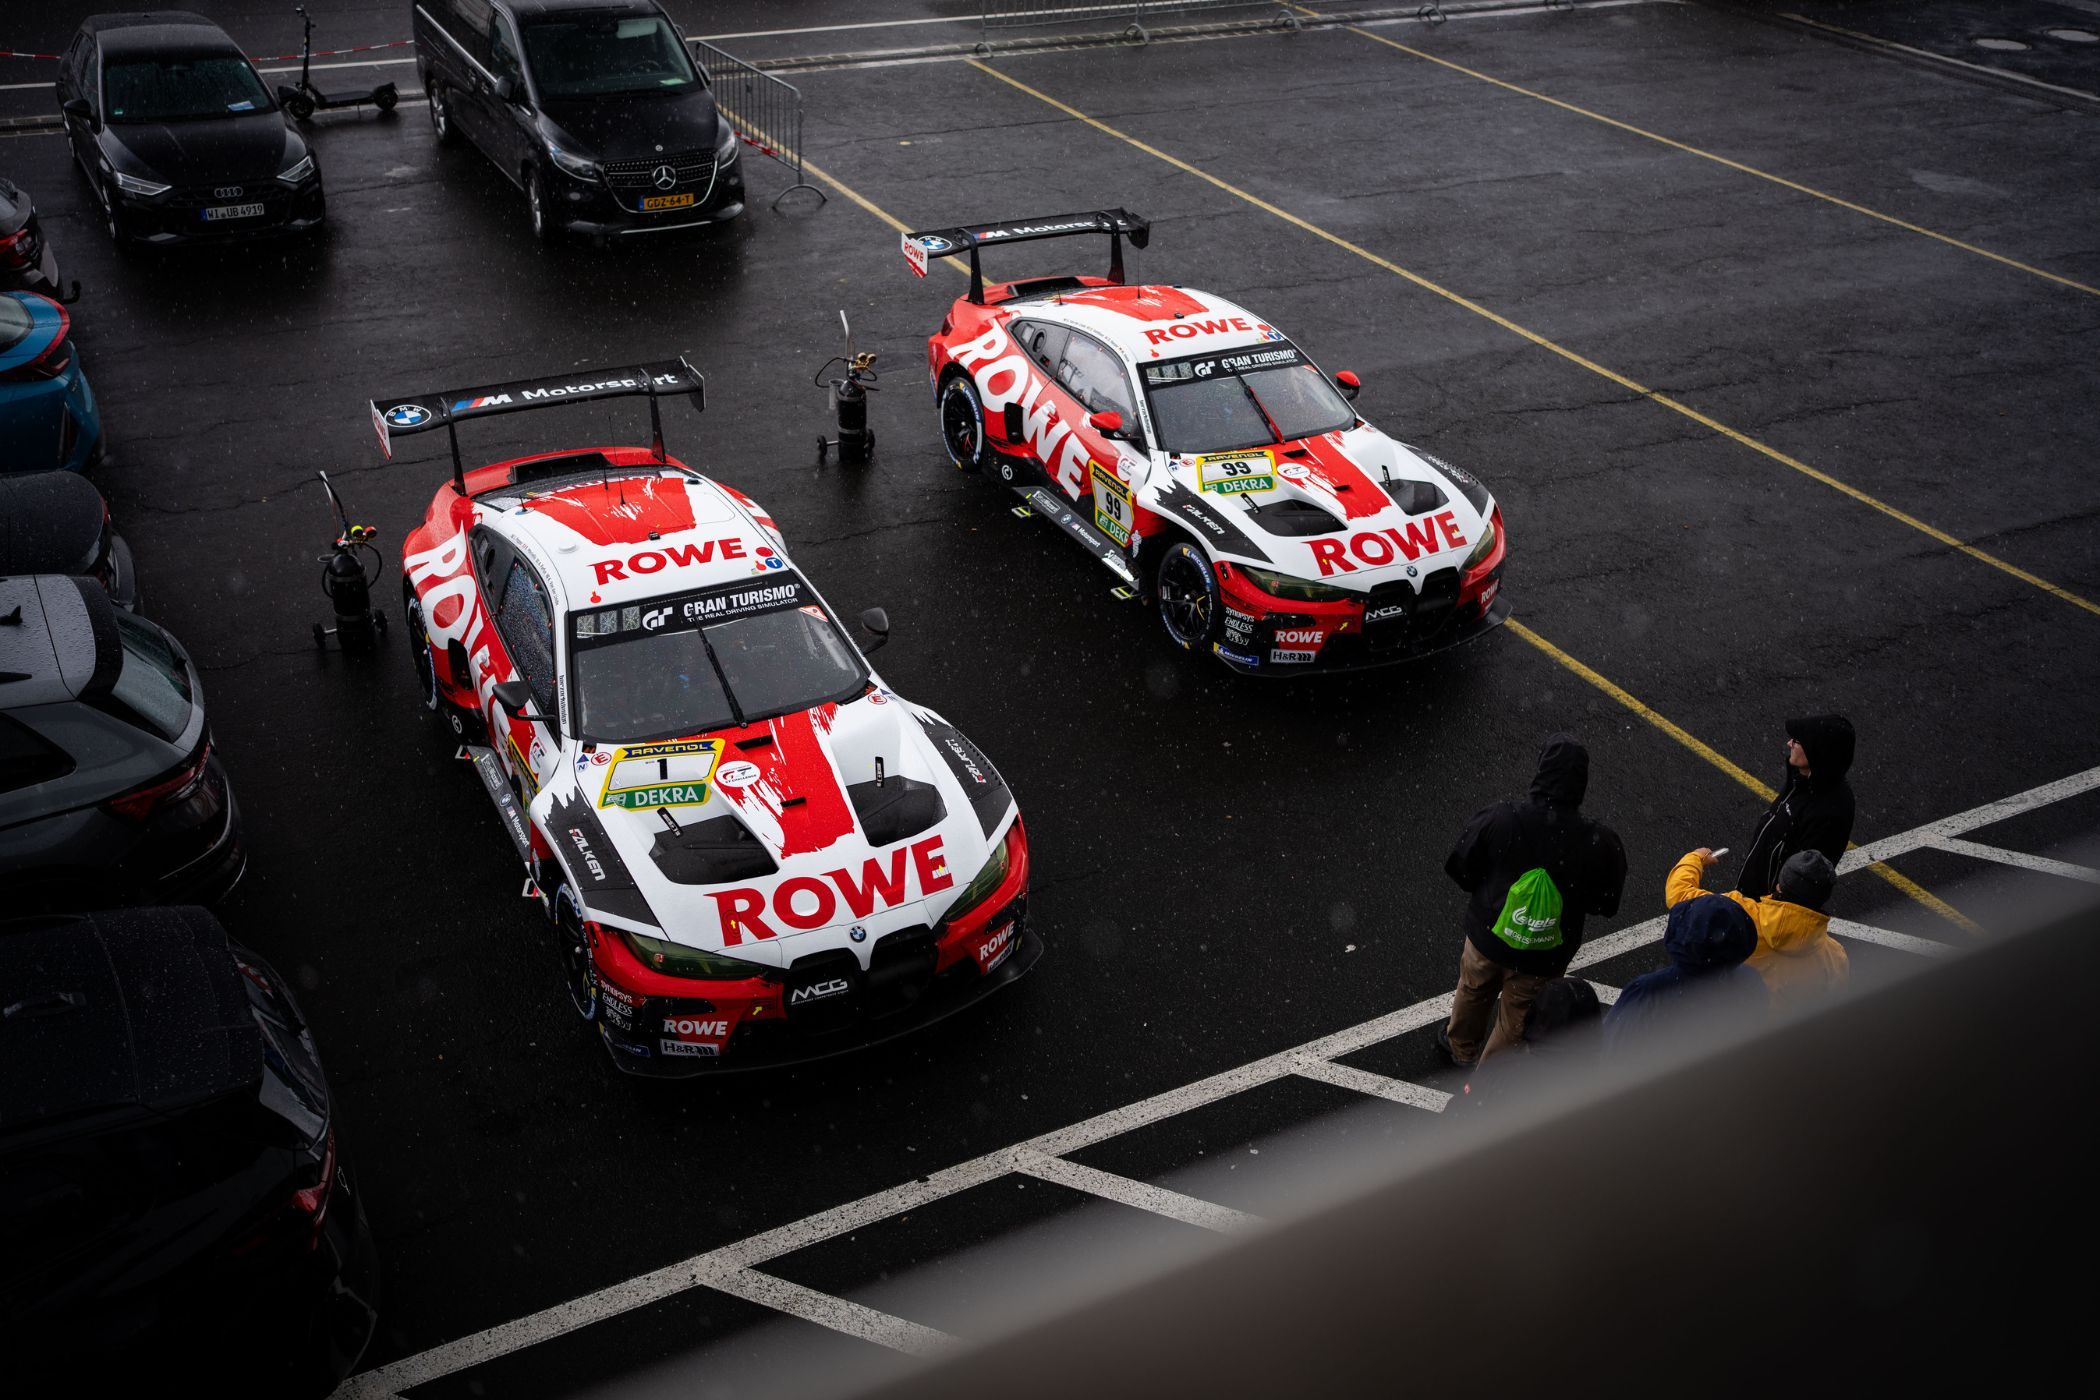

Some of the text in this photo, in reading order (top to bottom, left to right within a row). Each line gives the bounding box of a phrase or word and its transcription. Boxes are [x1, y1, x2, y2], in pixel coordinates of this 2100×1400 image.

[1139, 317, 1253, 345] ROWE
[1251, 350, 1297, 364] TURISMO
[947, 318, 1091, 502] ROWE
[1221, 462, 1252, 476] 99
[1222, 478, 1269, 493] DEKRA
[1105, 492, 1121, 520] 99
[1301, 510, 1467, 576] ROWE
[586, 537, 748, 586] ROWE
[683, 597, 728, 618] GRAN
[730, 585, 796, 608] TURISMO
[705, 610, 725, 620] REAL
[726, 606, 757, 616] DRIVING
[757, 597, 799, 610] SIMULATOR
[1224, 617, 1254, 633] ENDLESS
[1275, 630, 1324, 644] ROWE
[1273, 651, 1297, 661] H&R
[631, 744, 709, 756] RAVENOL
[657, 758, 669, 780] 1
[634, 786, 699, 807] DEKRA
[568, 828, 606, 881] FALKEN
[703, 835, 954, 947] ROWE
[979, 920, 1015, 961] ROWE
[791, 978, 848, 1003] MCG
[663, 1019, 728, 1036] ROWE
